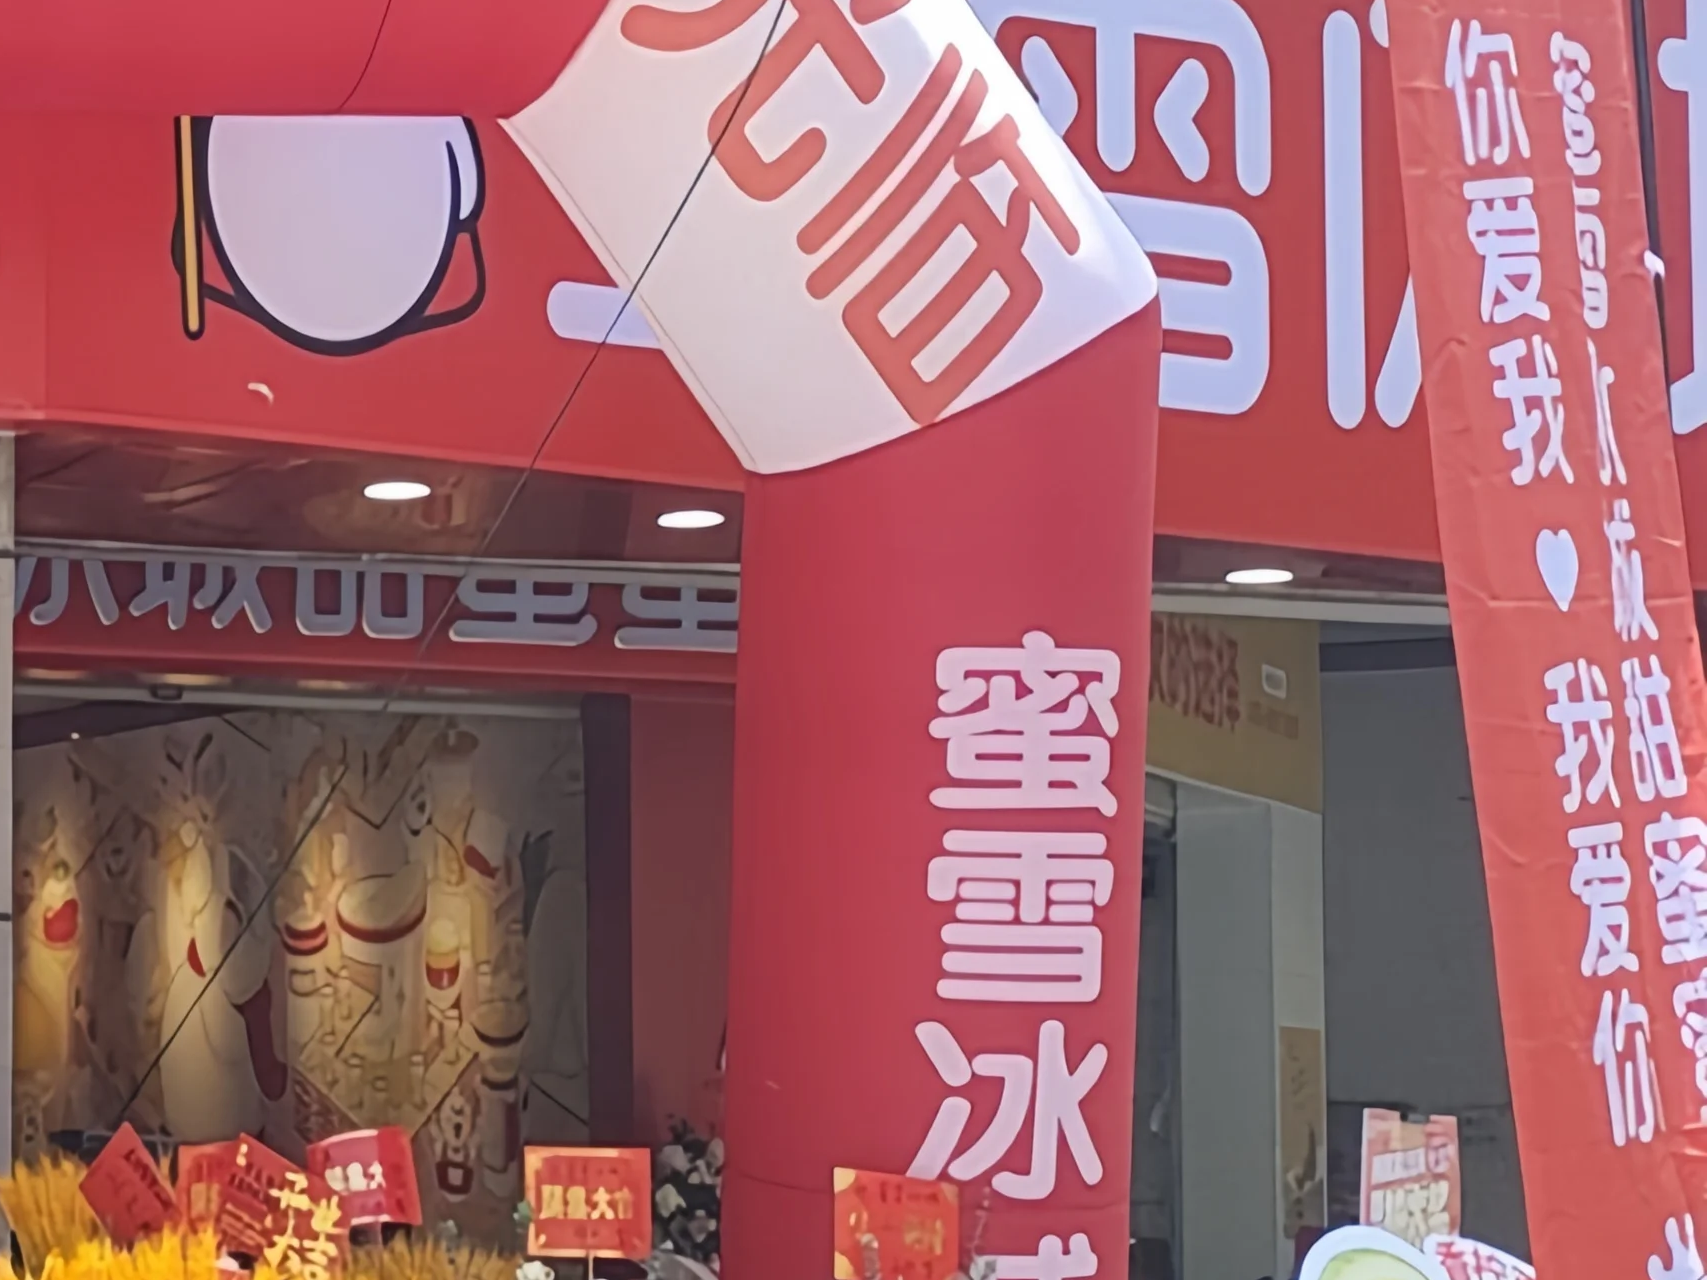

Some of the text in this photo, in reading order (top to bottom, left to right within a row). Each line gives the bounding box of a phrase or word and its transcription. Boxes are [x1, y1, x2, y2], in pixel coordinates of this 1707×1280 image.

[1443, 18, 1576, 488] 你爱我
[1544, 657, 1667, 1148] 我爱你
